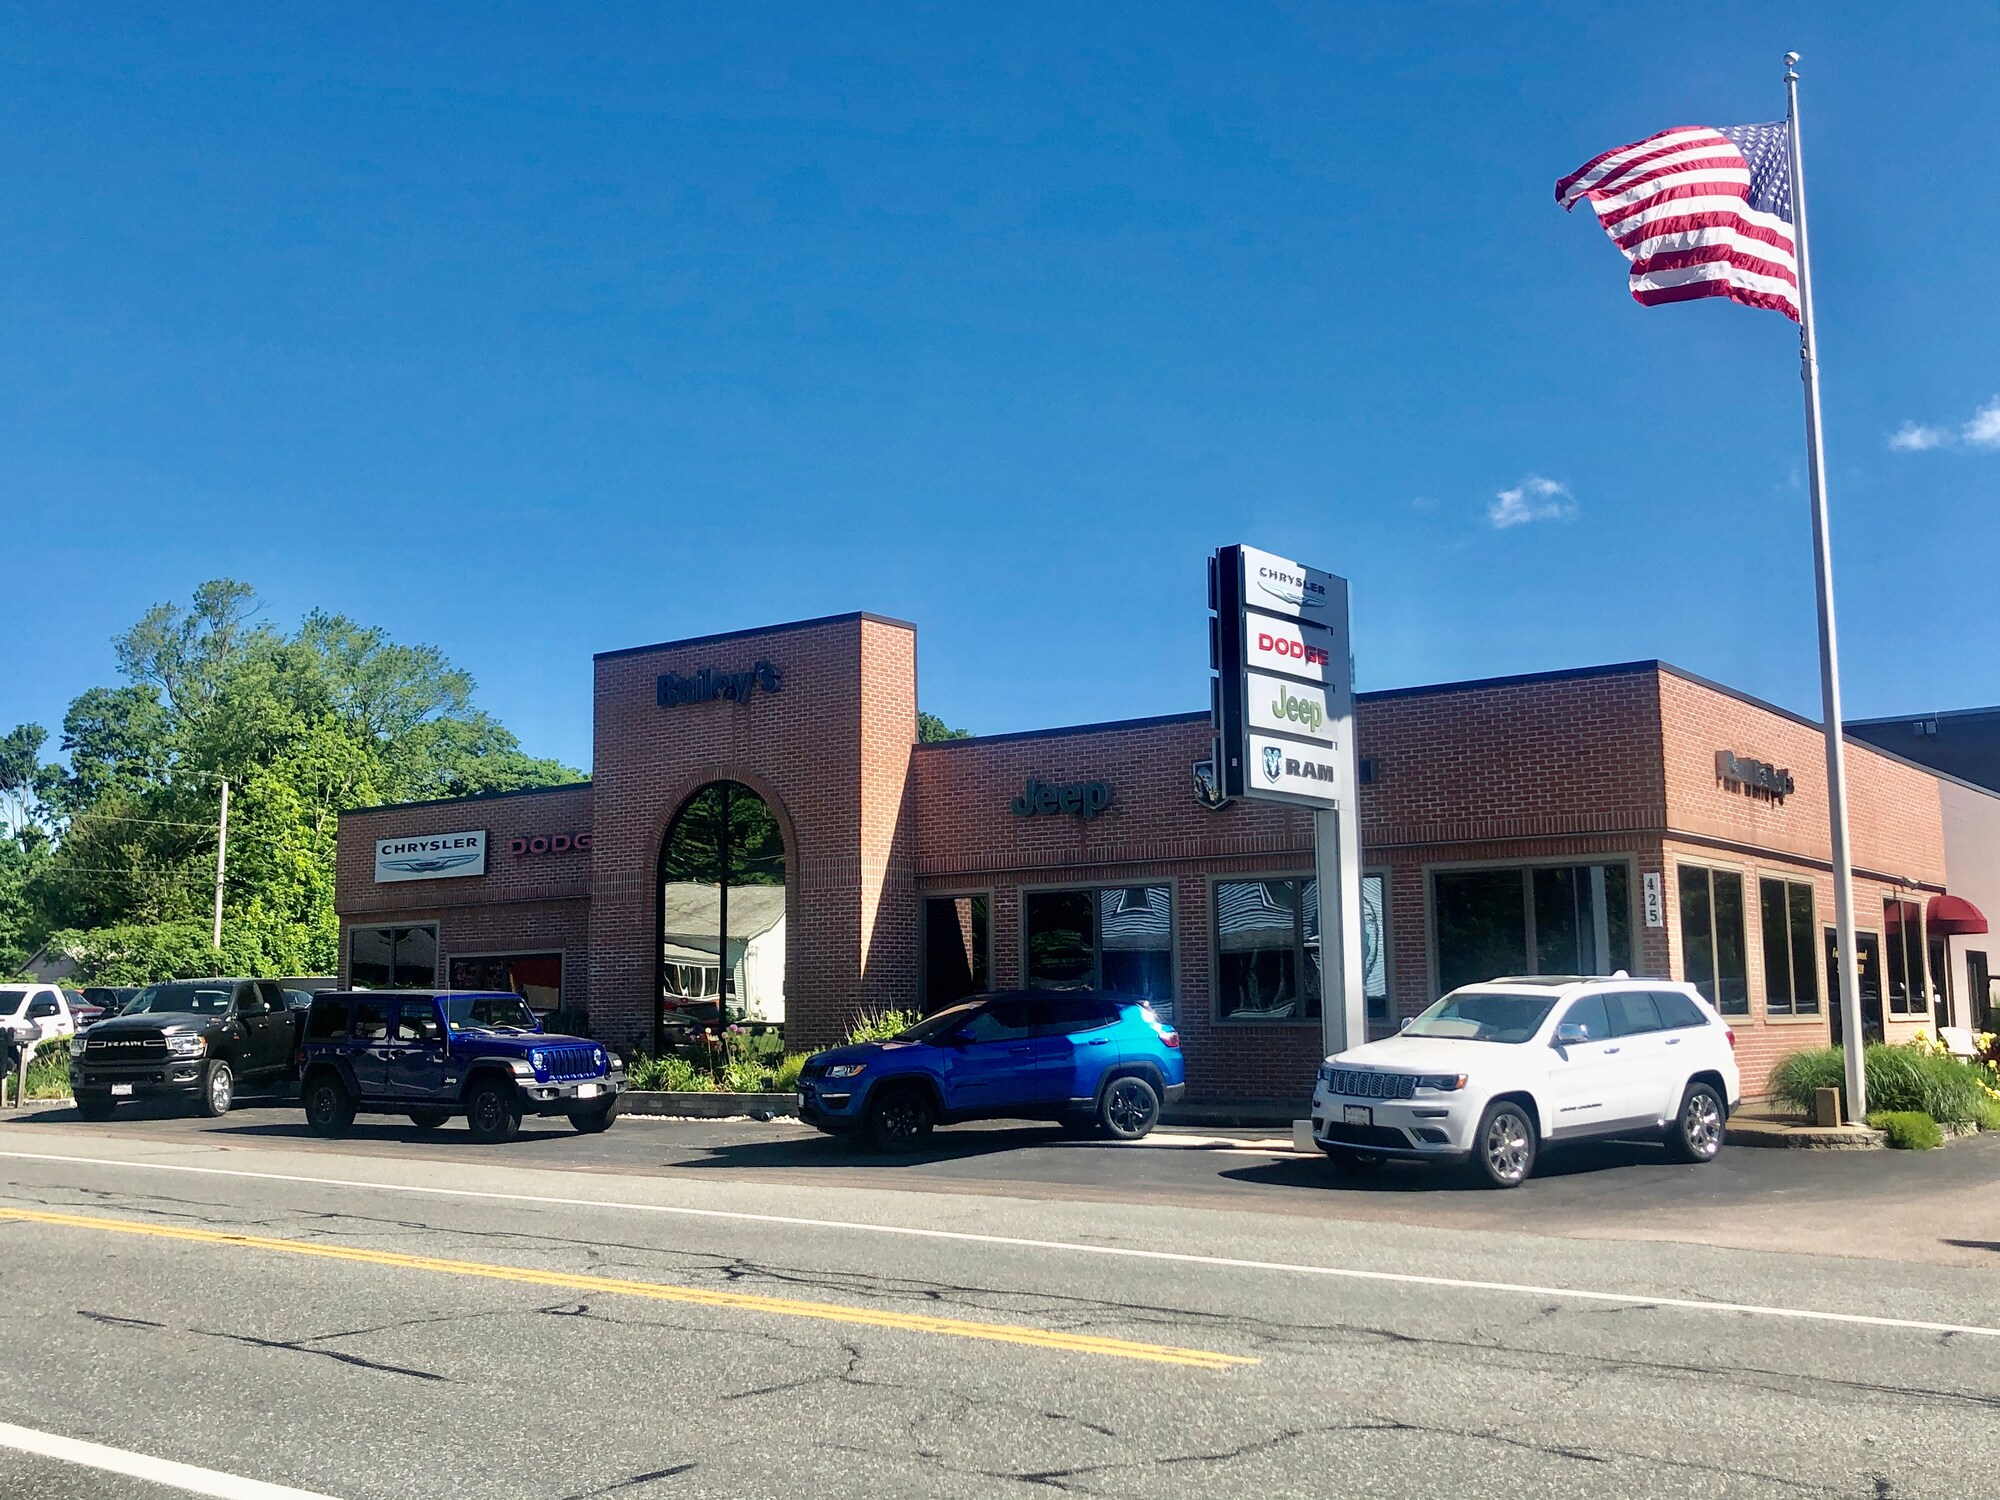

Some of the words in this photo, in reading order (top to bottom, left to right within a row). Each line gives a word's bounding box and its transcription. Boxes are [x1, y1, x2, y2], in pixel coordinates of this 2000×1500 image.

[1259, 567, 1325, 595] CHRYSLER
[1258, 633, 1329, 666] DODGE
[657, 660, 781, 706] Bailey's
[1272, 685, 1322, 732] Jeep
[1285, 758, 1334, 783] RAM
[1011, 778, 1107, 820] Jeep
[381, 837, 478, 855] CHRYSLER
[506, 832, 592, 855] DODG
[1647, 878, 1658, 922] 425
